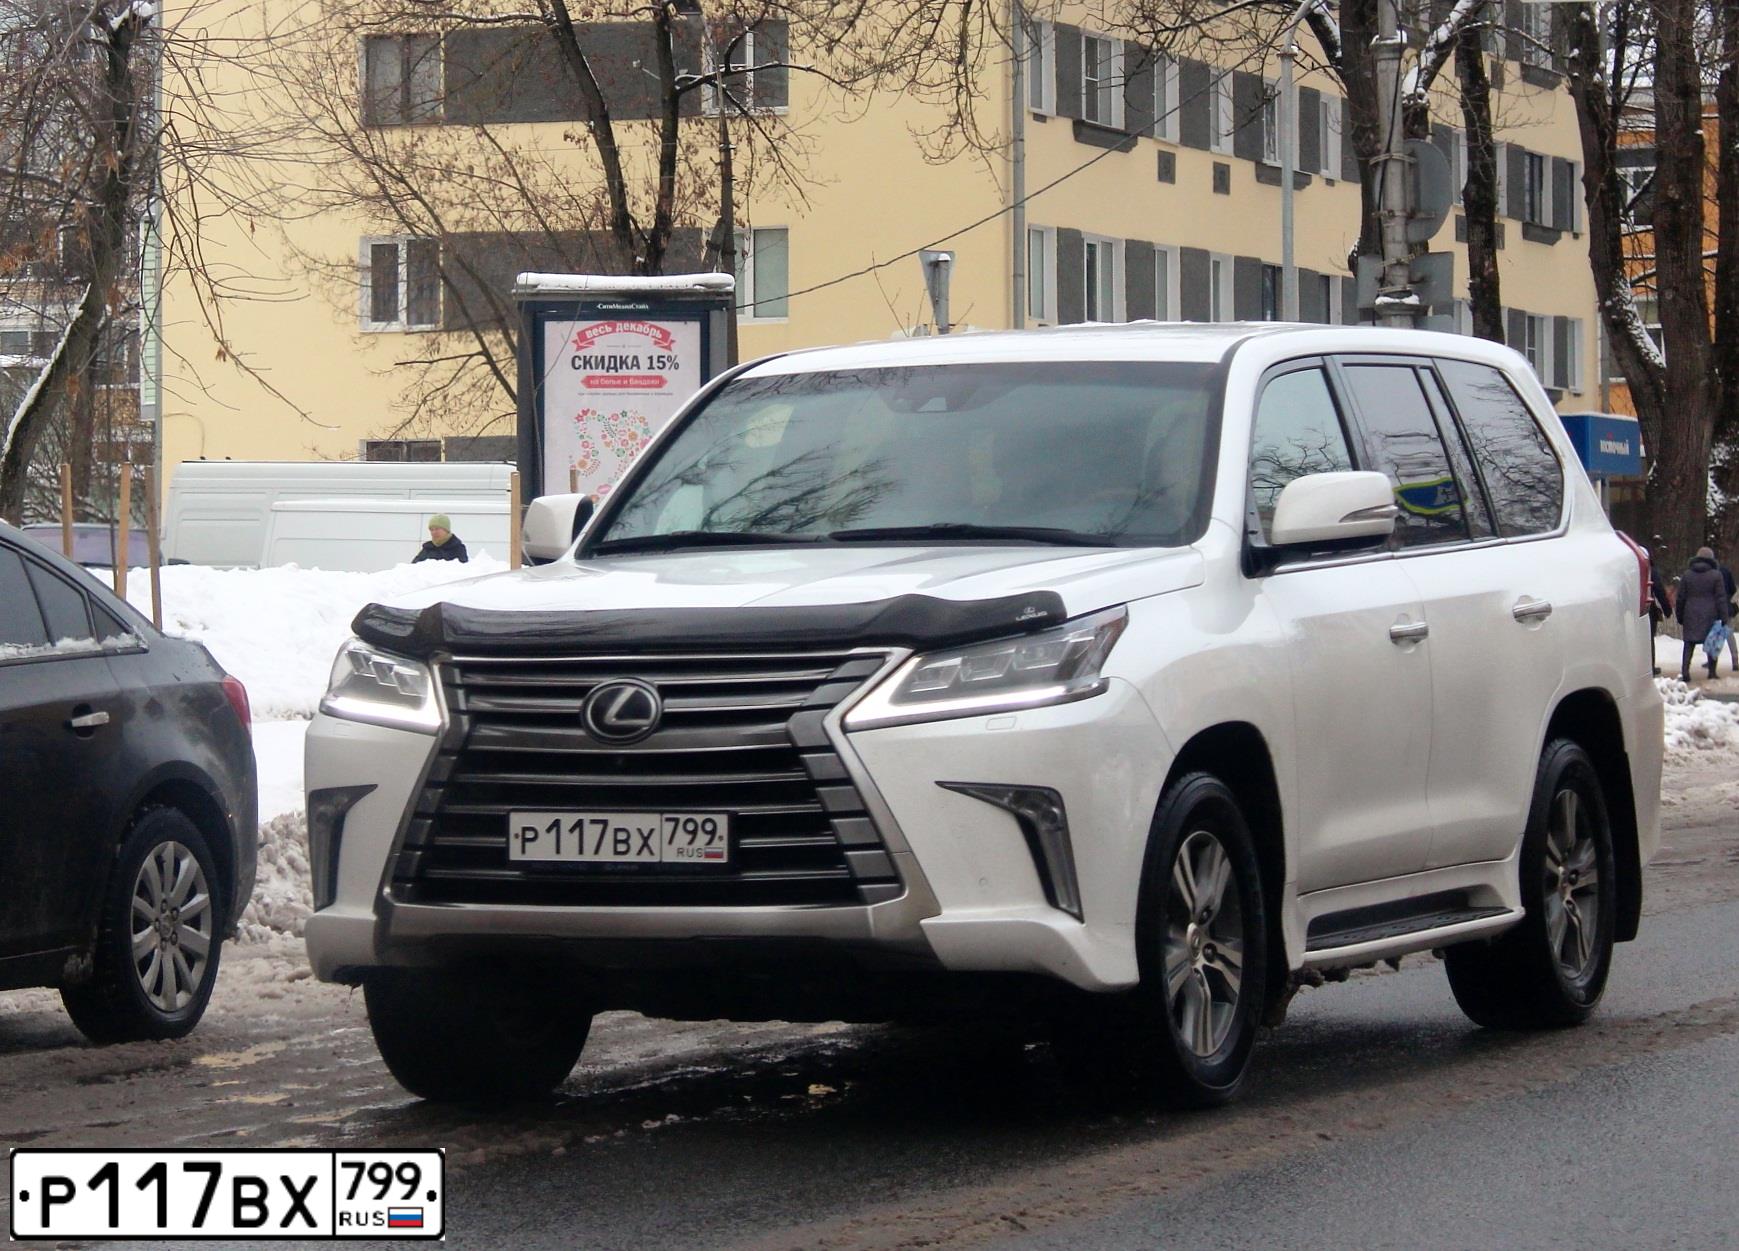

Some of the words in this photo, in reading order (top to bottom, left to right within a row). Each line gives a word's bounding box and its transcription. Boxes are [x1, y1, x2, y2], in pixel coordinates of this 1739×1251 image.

[584, 323, 613, 339] весь
[615, 322, 663, 339] декабрь
[571, 354, 641, 373] СКИДКА
[647, 354, 680, 371] 15%
[664, 817, 718, 846] 799
[676, 847, 704, 858] RUS
